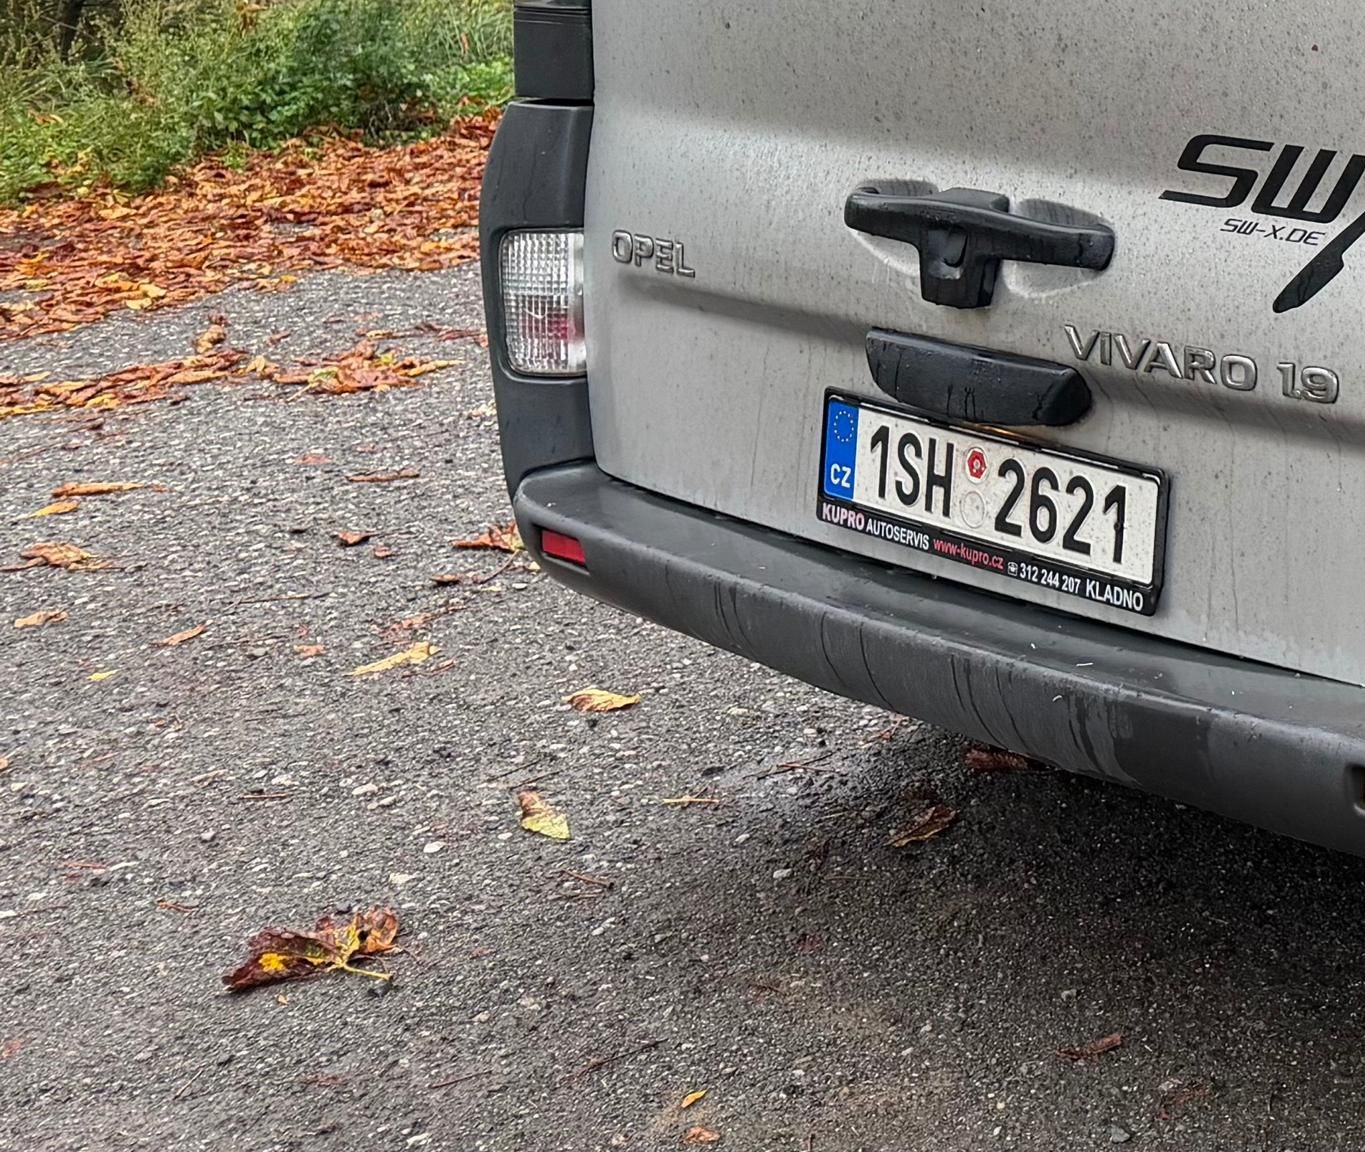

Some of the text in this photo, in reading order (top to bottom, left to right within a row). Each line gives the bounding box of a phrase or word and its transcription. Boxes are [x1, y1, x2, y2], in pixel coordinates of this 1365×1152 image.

[611, 229, 696, 278] OPEL
[1220, 218, 1326, 247] SW-X.DE
[1063, 323, 1258, 392] VIVARO
[829, 463, 852, 488] CZ
[869, 424, 1127, 564] 1SH 2621
[822, 501, 865, 531] KUPRO
[865, 519, 930, 551] AUTOSERVIS
[1019, 563, 1038, 582] 312
[1041, 568, 1060, 588] 244
[1062, 575, 1081, 594] 207
[1085, 579, 1144, 613] KLADNO
